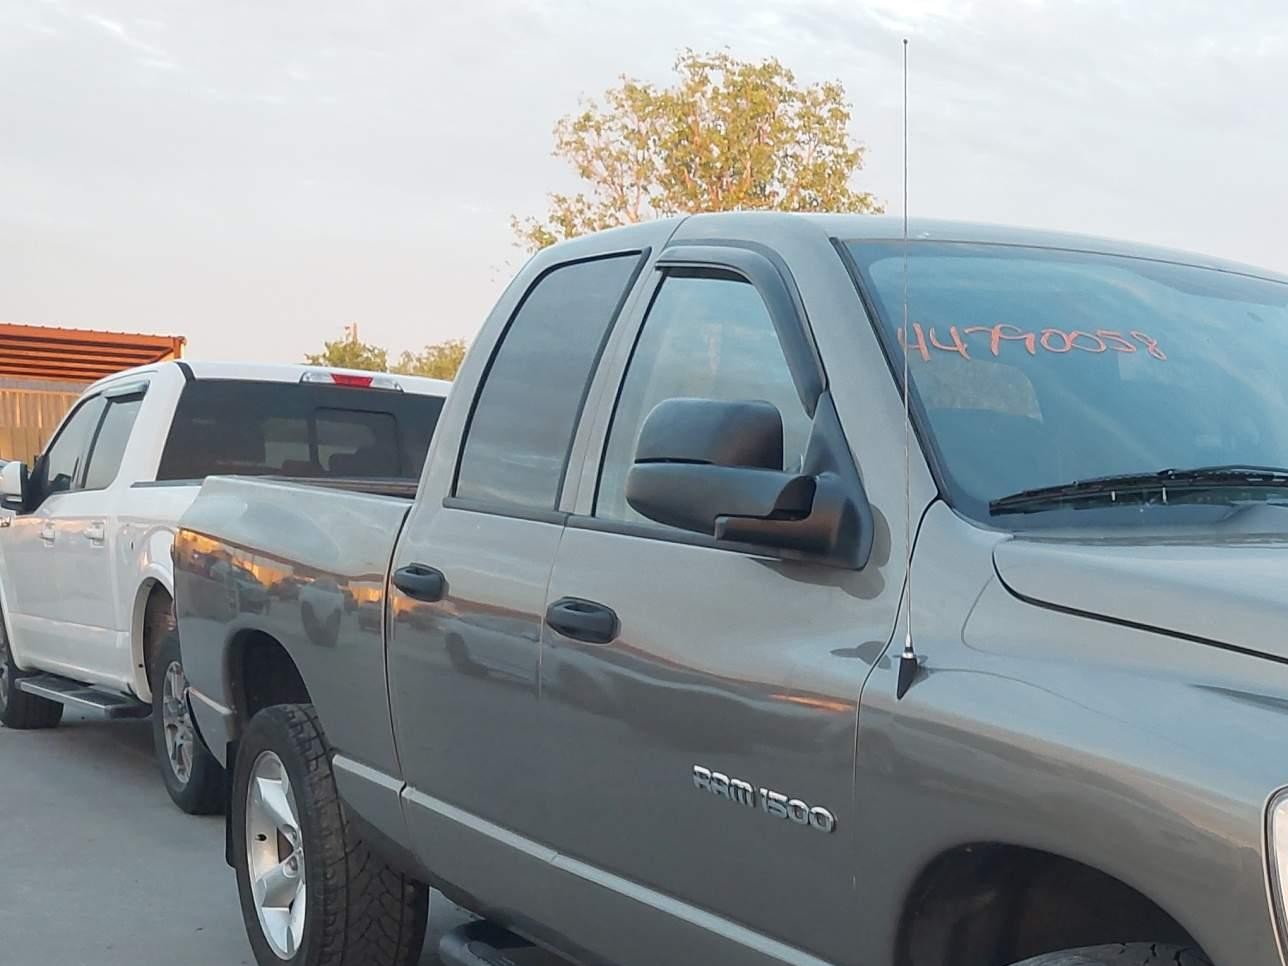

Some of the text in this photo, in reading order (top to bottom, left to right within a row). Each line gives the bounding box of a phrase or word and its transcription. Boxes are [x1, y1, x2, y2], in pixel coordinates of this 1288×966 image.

[897, 322, 1168, 361] 44790058
[692, 764, 837, 833] RAM 1500
